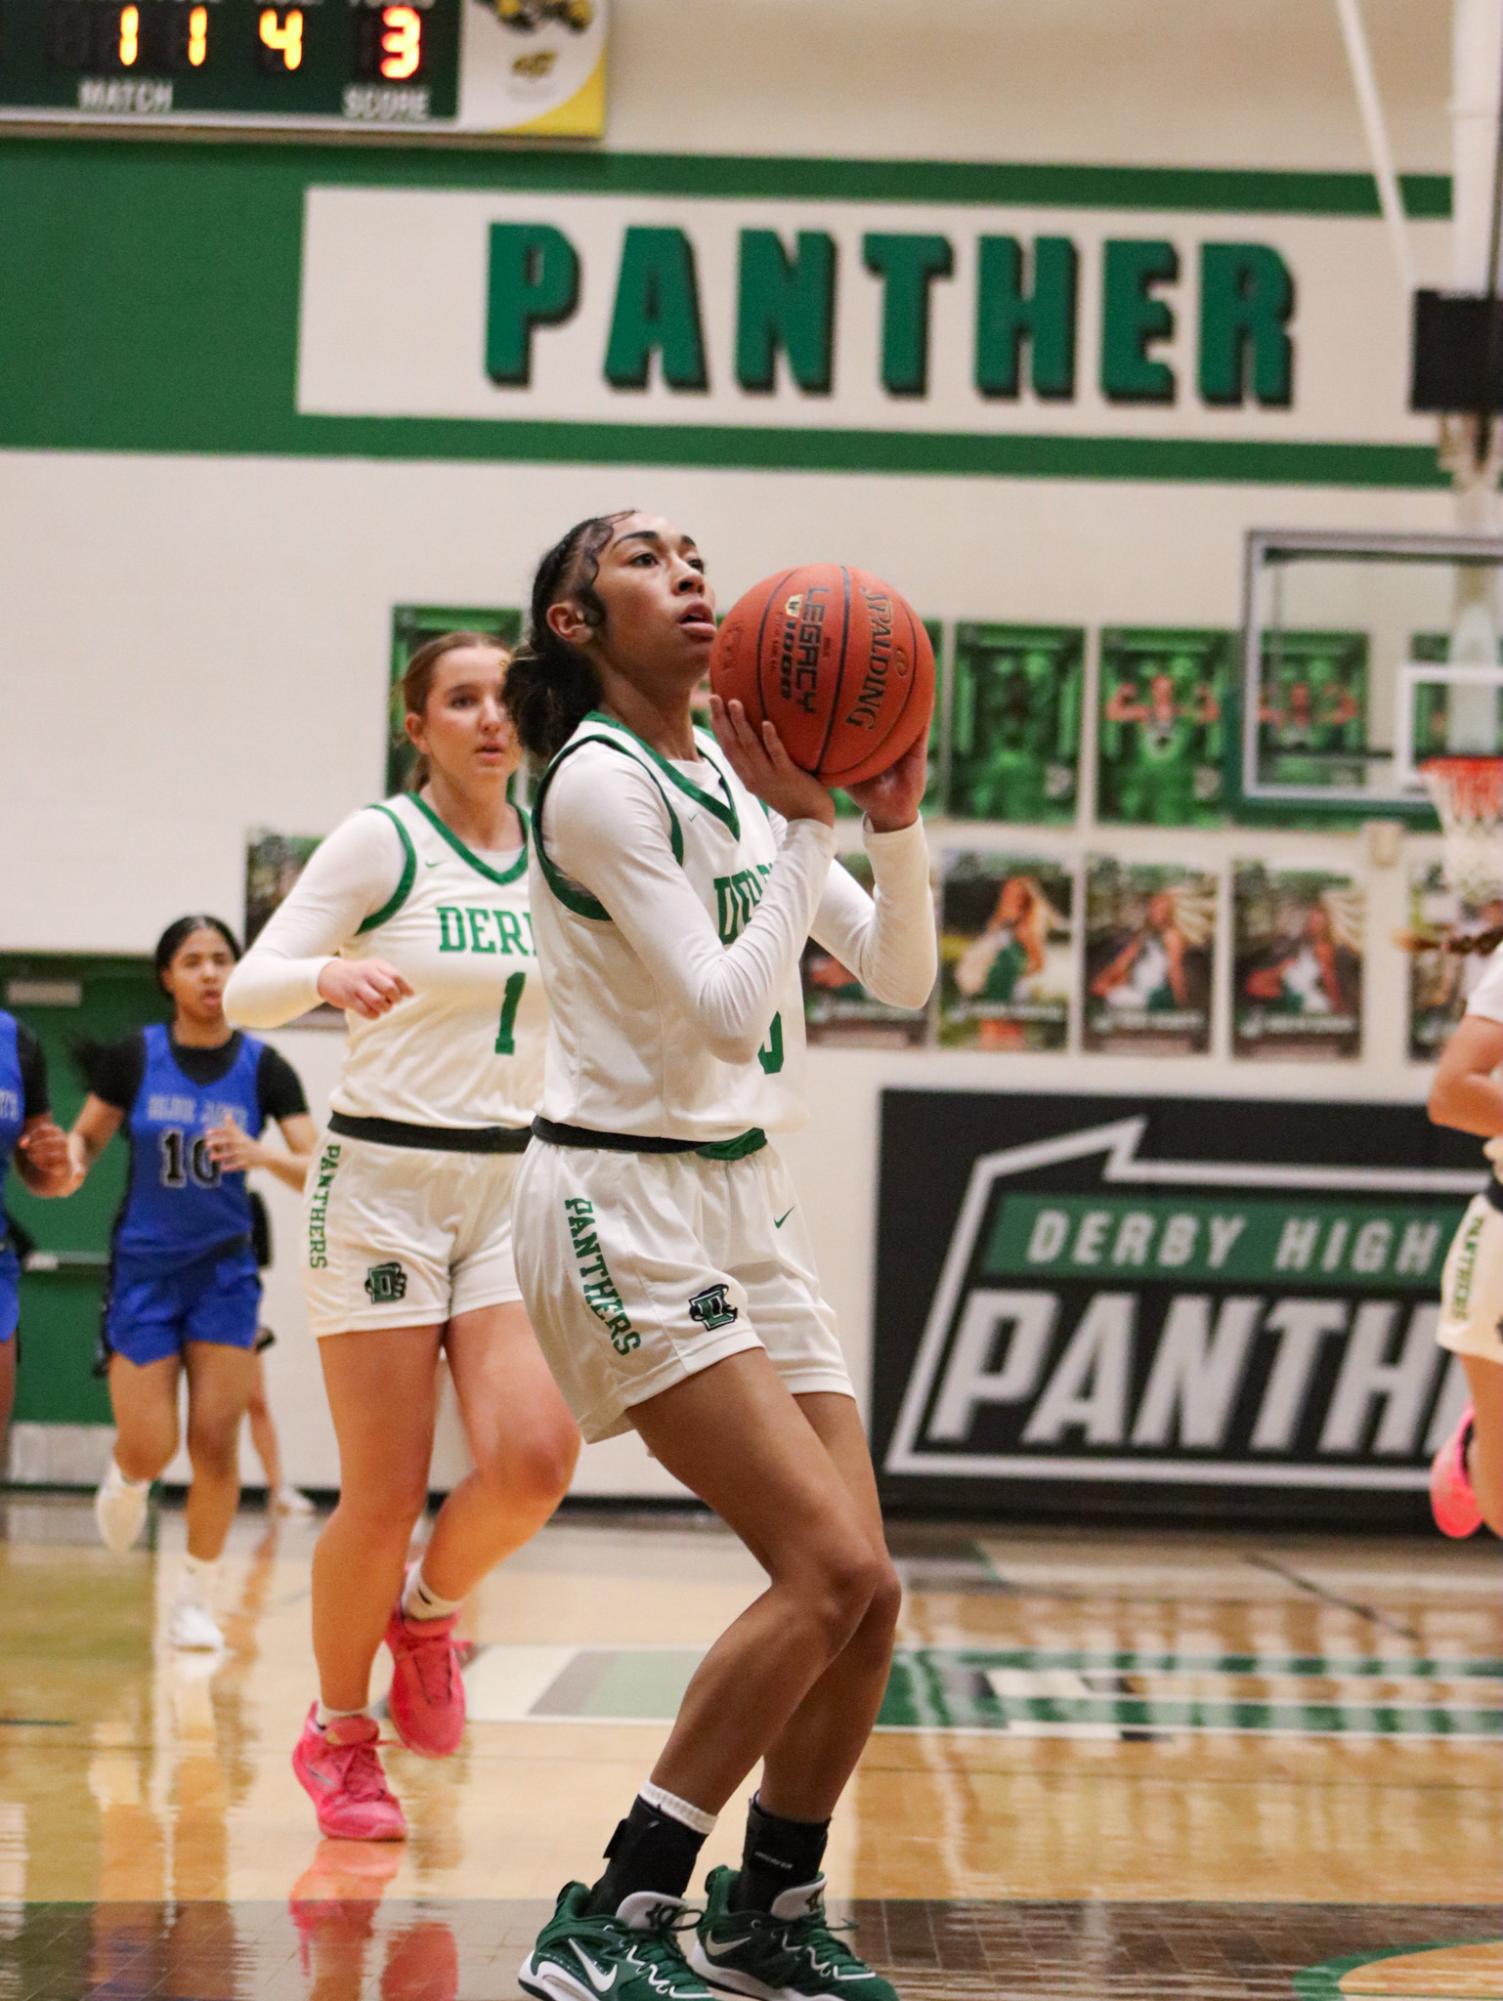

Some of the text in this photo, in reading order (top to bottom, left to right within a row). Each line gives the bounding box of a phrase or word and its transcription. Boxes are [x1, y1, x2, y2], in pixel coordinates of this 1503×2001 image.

[258, 7, 304, 71] 4
[378, 5, 421, 79] 3
[77, 78, 174, 112] MATCH
[342, 86, 430, 120] SCORE
[484, 220, 1297, 411] PANTHER
[796, 587, 830, 713] LEGACY
[845, 586, 893, 731] SPALDING
[494, 971, 526, 1055] 1
[160, 1128, 222, 1188] 10
[309, 1144, 341, 1269] PANTHERS
[1026, 1209, 1445, 1276] DERBY HIGH
[564, 1197, 641, 1356] PANTHERS
